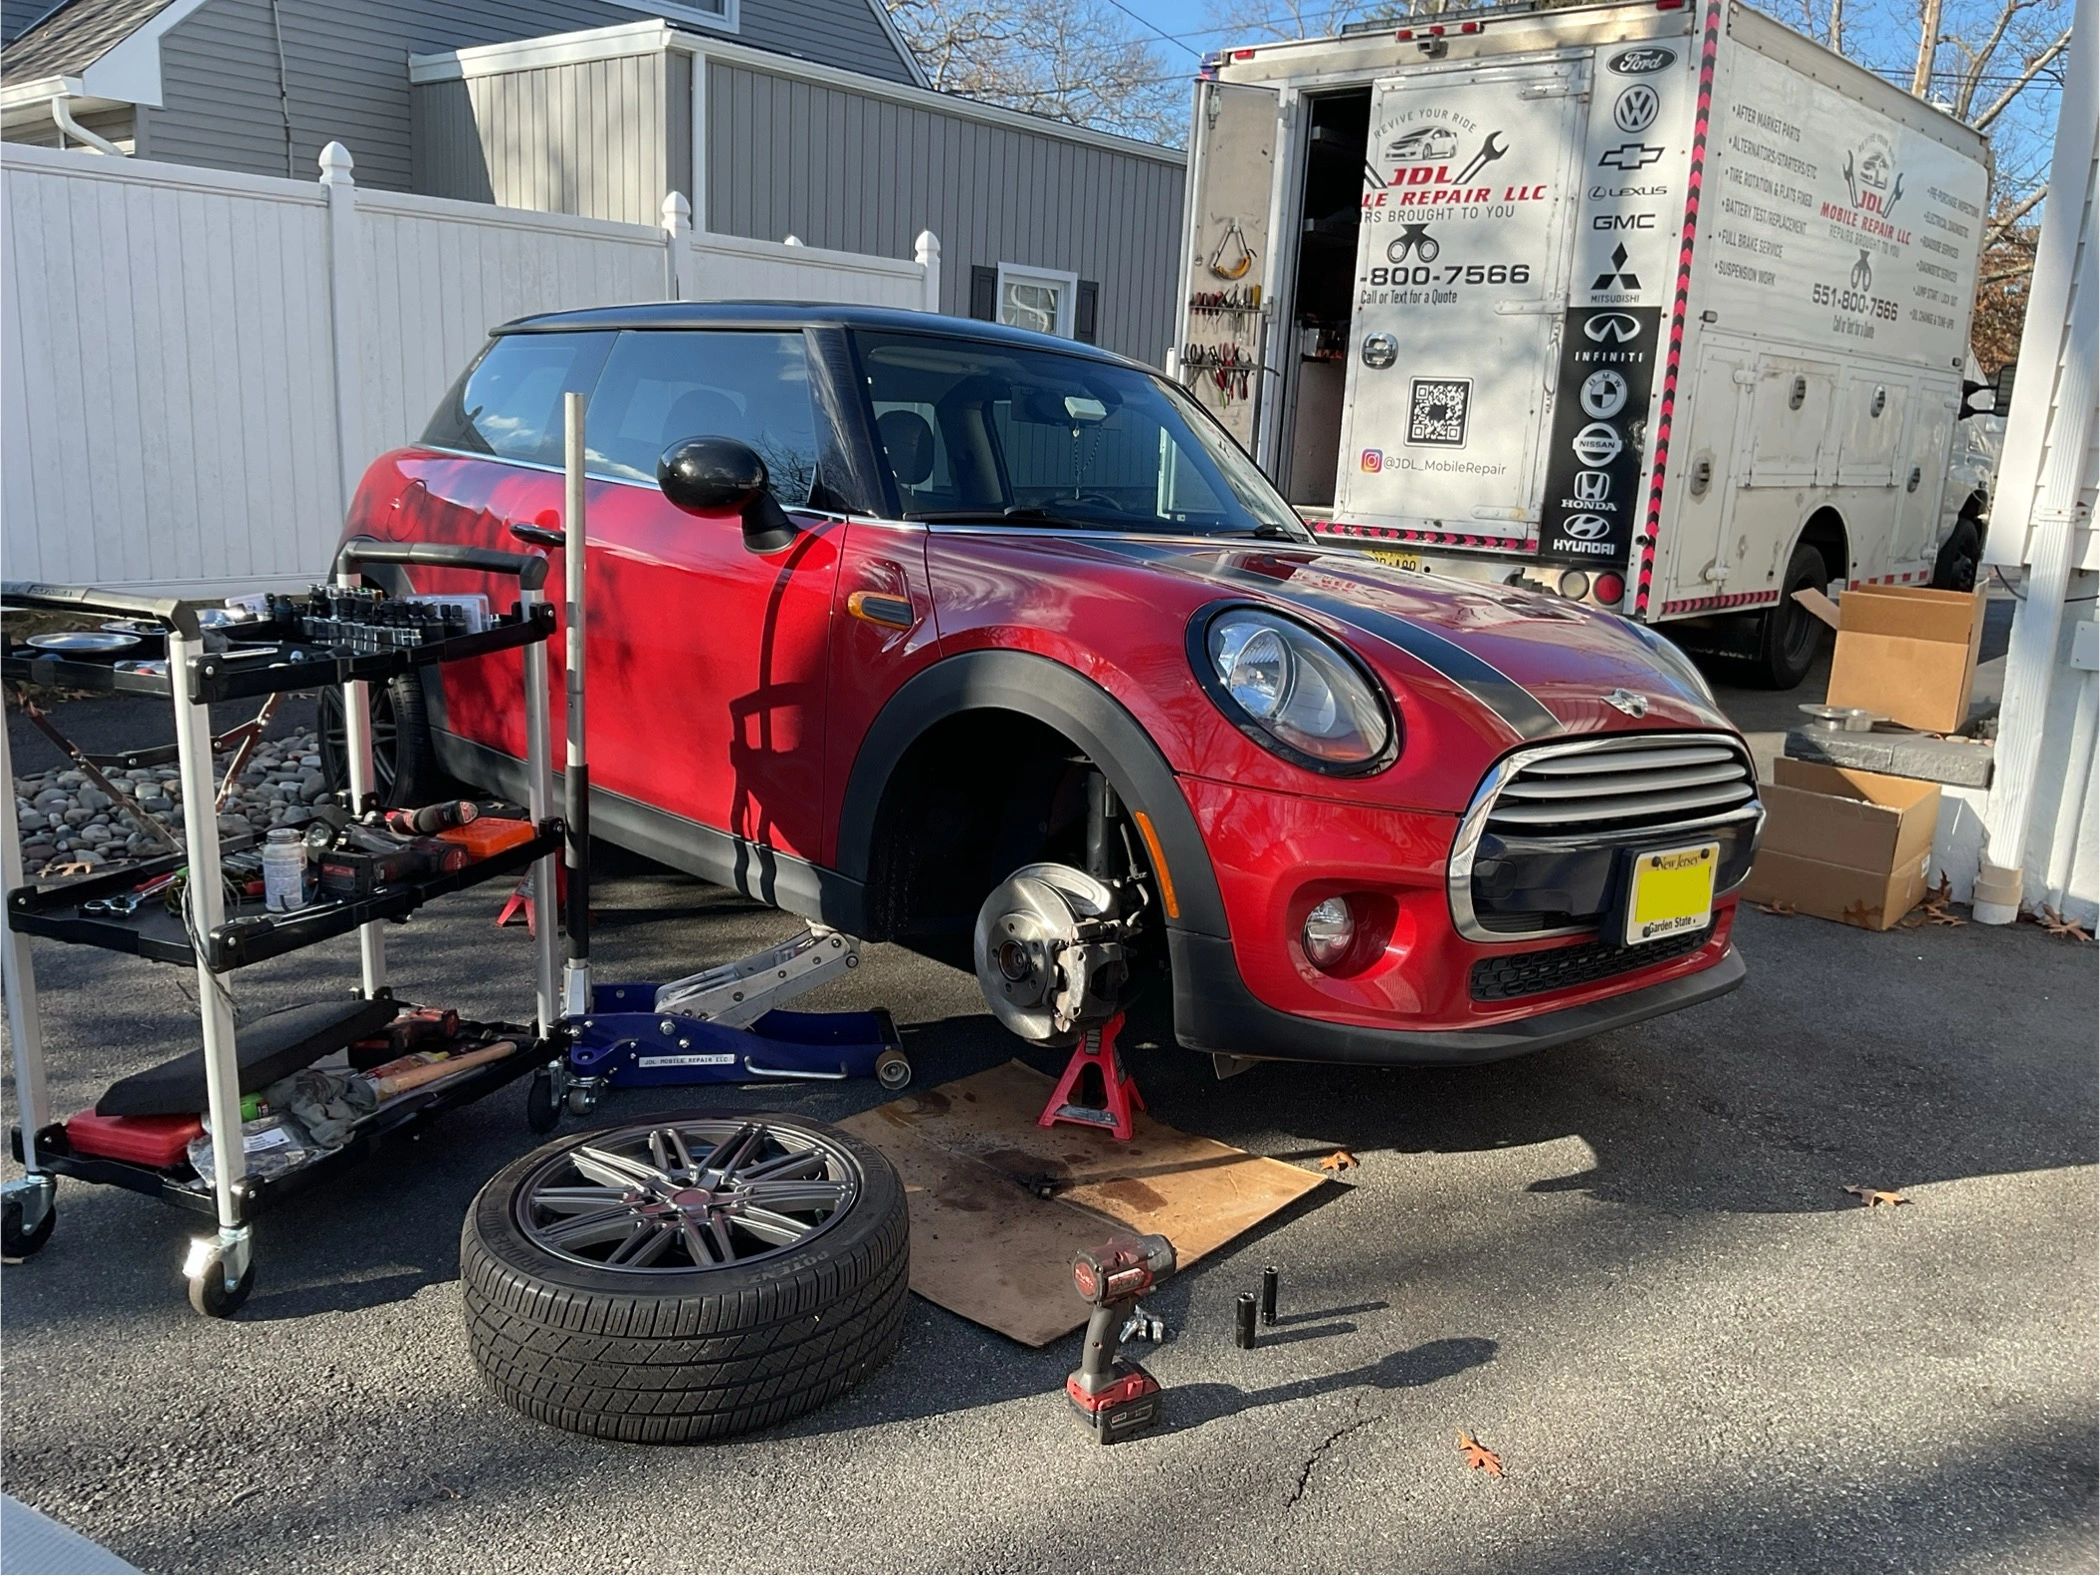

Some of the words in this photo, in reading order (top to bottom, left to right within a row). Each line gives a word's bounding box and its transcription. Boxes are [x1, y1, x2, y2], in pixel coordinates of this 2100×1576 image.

[1620, 50, 1662, 71] Ford
[1374, 112, 1413, 138] REVIVE
[1420, 109, 1448, 120] YOUR
[1452, 113, 1477, 133] RIDE
[1736, 104, 1757, 124] AFTER
[1757, 112, 1782, 134] MARKET
[1782, 121, 1801, 142] PARTS
[1388, 166, 1453, 187] JDL
[1730, 166, 1743, 185] TIRE
[1744, 171, 1773, 195] ROTATION
[1400, 188, 1491, 206] REPAIR
[1504, 185, 1547, 201] LLC
[1609, 186, 1667, 197] LEXUS
[1725, 198, 1752, 219] BATTERY
[1858, 190, 1883, 215] JDL
[1388, 208, 1454, 222] BROUGHT
[1462, 207, 1478, 219] TO
[1486, 205, 1515, 218] YOU
[1593, 214, 1656, 230] GMC
[1820, 202, 1858, 227] MOBILE
[1861, 216, 1895, 239] REPAIR
[1897, 228, 1912, 246] LLC
[1722, 229, 1737, 247] FULL
[1738, 233, 1758, 253] BRAKE
[1759, 240, 1783, 259] SERVICE
[1718, 260, 1757, 282] SUSPENSION
[1758, 270, 1776, 286] WORK
[1360, 290, 1377, 305] Call
[1378, 293, 1388, 304] or
[1390, 290, 1407, 305] Text
[1409, 290, 1422, 304] for
[1424, 292, 1429, 303] a
[1431, 289, 1457, 305] Quote
[1591, 295, 1640, 303] MITSUBISHI
[1812, 283, 1898, 321] 551-800-7566
[1575, 352, 1643, 362] INFINITI
[1579, 440, 1615, 449] NISSAN
[1383, 456, 1507, 476] @JDL_MobileRepair
[1561, 499, 1617, 512] HONDA
[1553, 539, 1615, 555] HYUNDAI
[1657, 857, 1674, 871] New
[1675, 855, 1700, 870] Jersey
[1649, 920, 1673, 933] Garden
[1675, 916, 1692, 928] State
